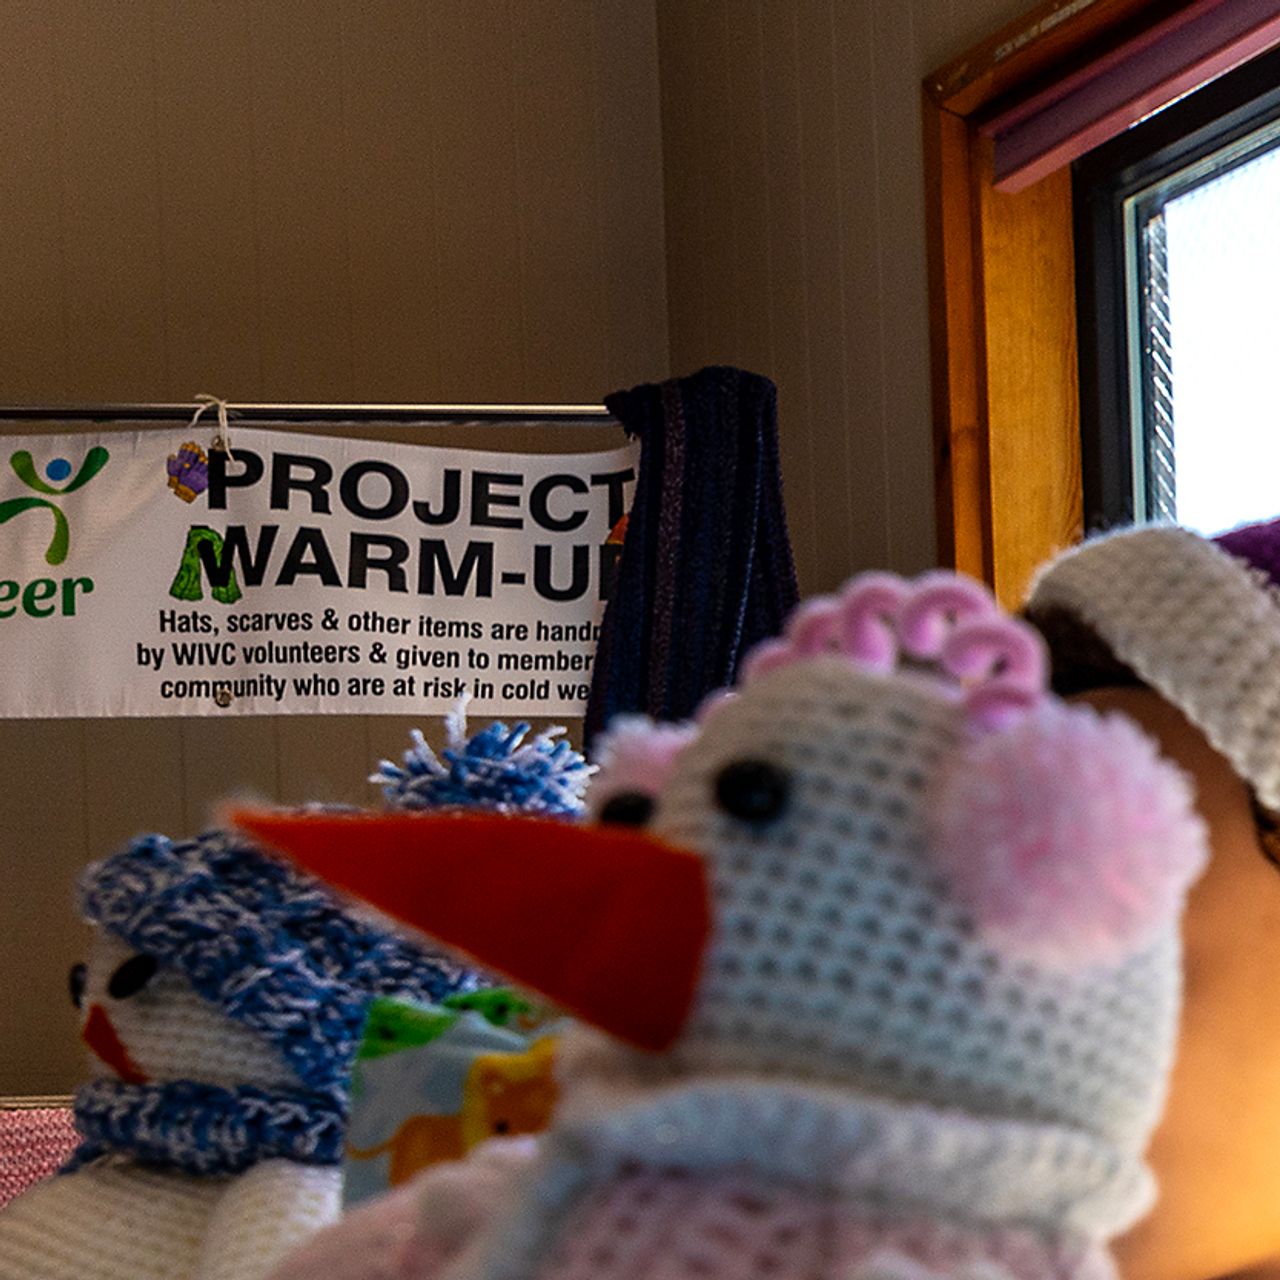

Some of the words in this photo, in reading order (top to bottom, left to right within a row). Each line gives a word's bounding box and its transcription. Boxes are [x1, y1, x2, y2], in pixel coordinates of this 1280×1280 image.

[208, 448, 635, 532] PROJECT
[159, 609, 219, 637] Hats,
[227, 612, 313, 633] scarves
[321, 608, 339, 631] &
[348, 610, 411, 635] other
[418, 615, 483, 639] items
[491, 622, 528, 641] are
[137, 643, 165, 671] by
[172, 642, 236, 666] WIVC
[242, 641, 361, 664] volunteers
[369, 641, 387, 664] &
[396, 645, 460, 670] given
[468, 648, 489, 669] to
[161, 673, 286, 702] community
[293, 674, 339, 697] who
[347, 676, 385, 697] are
[393, 676, 415, 697] at
[423, 677, 466, 698] risk
[474, 678, 494, 699] in
[502, 679, 550, 700] cold
